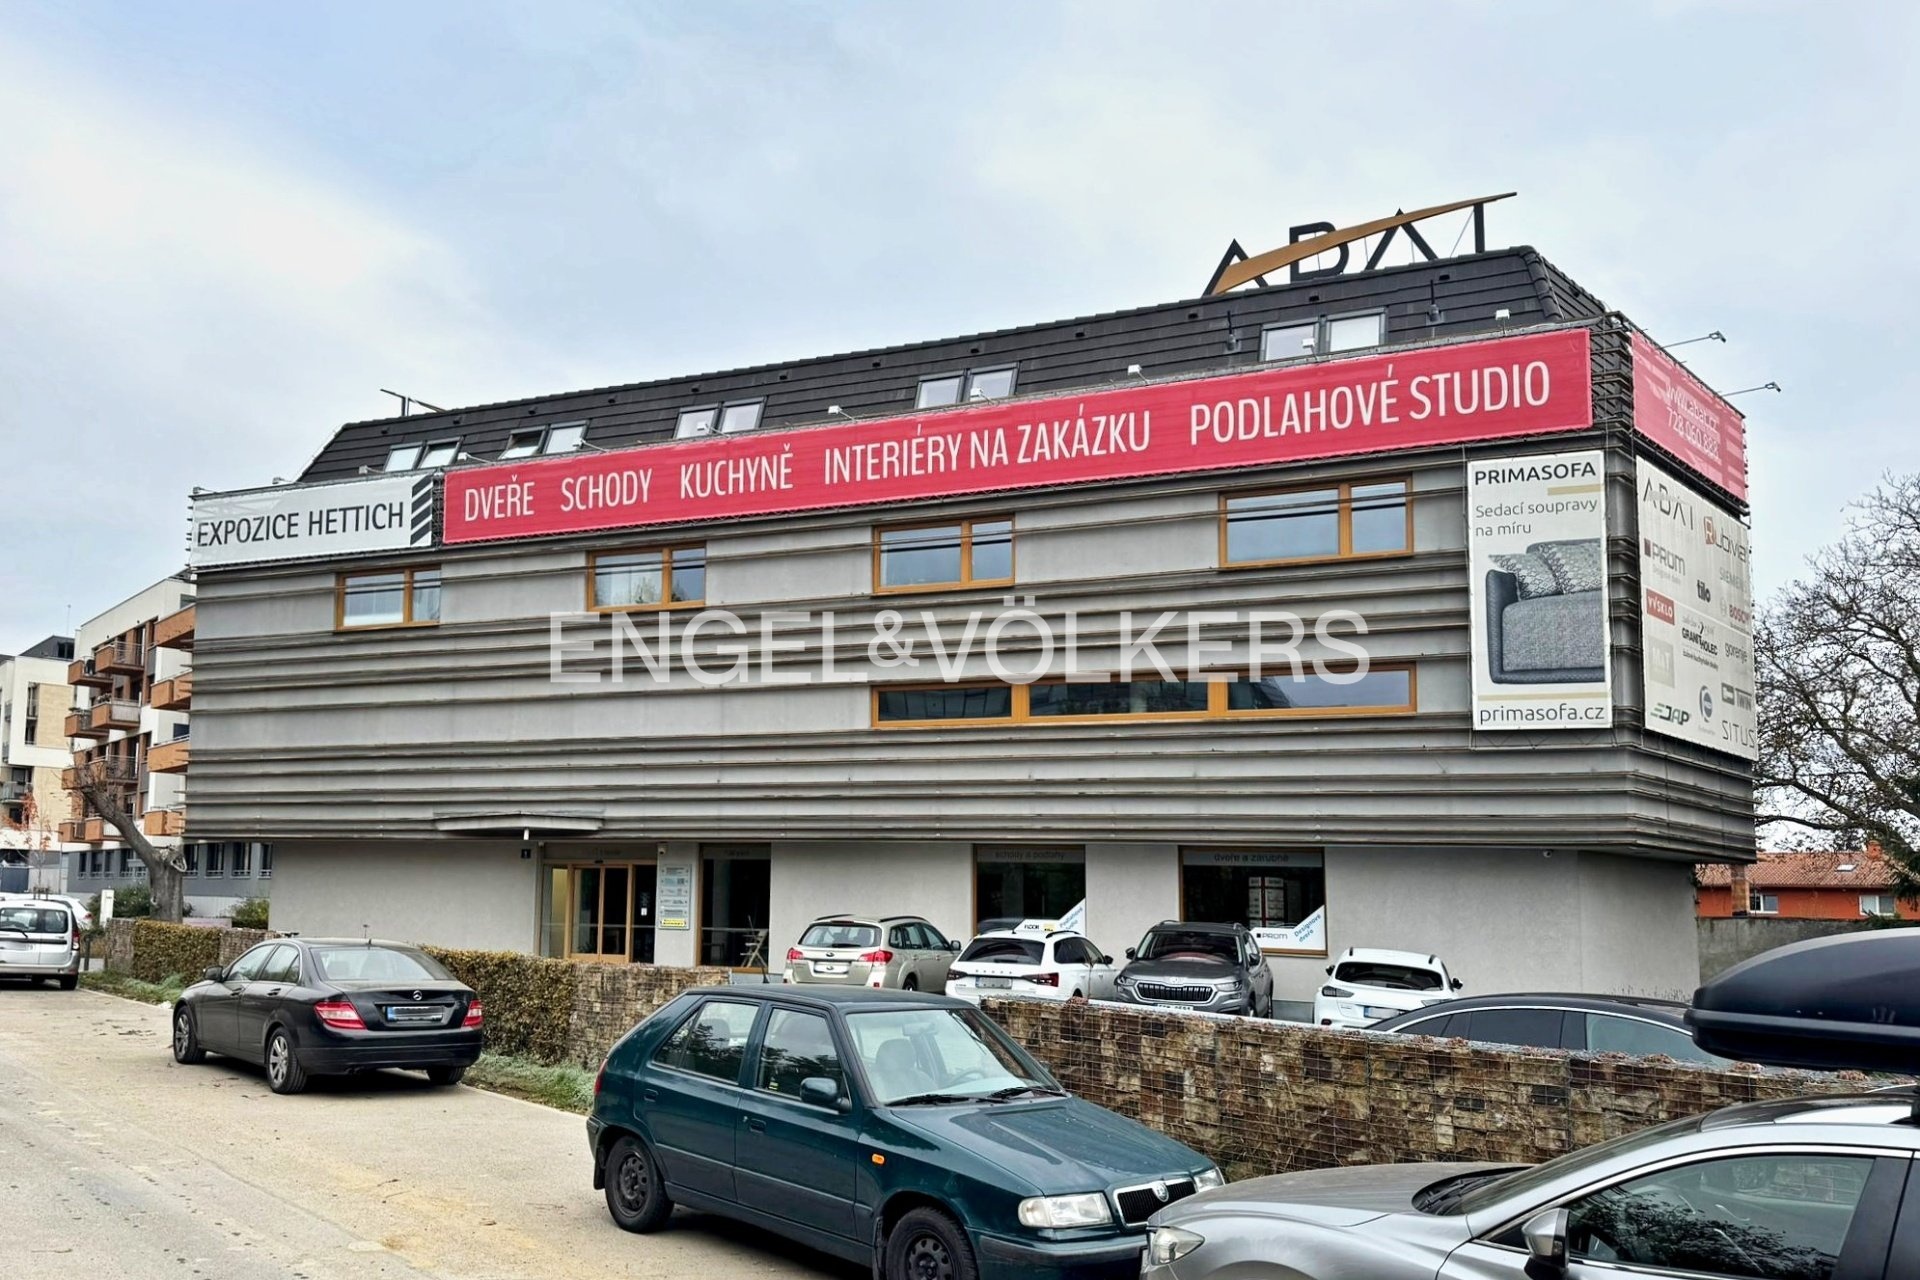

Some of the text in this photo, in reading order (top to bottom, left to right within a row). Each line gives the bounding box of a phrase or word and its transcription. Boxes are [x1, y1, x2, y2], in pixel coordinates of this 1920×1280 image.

[464, 360, 1550, 521] DVEŘE SCHODY KUCHYNĚ INTERIÉRY NA ZAKÁZKU PODLAHOVÉ STUDIO
[1475, 461, 1596, 485] PRIMASOFA
[1475, 498, 1598, 518] Sedací soupravy
[197, 501, 404, 547] EXPOZICE HETTICH
[1475, 521, 1532, 537] na míru
[1480, 703, 1605, 725] primasofa.cz
